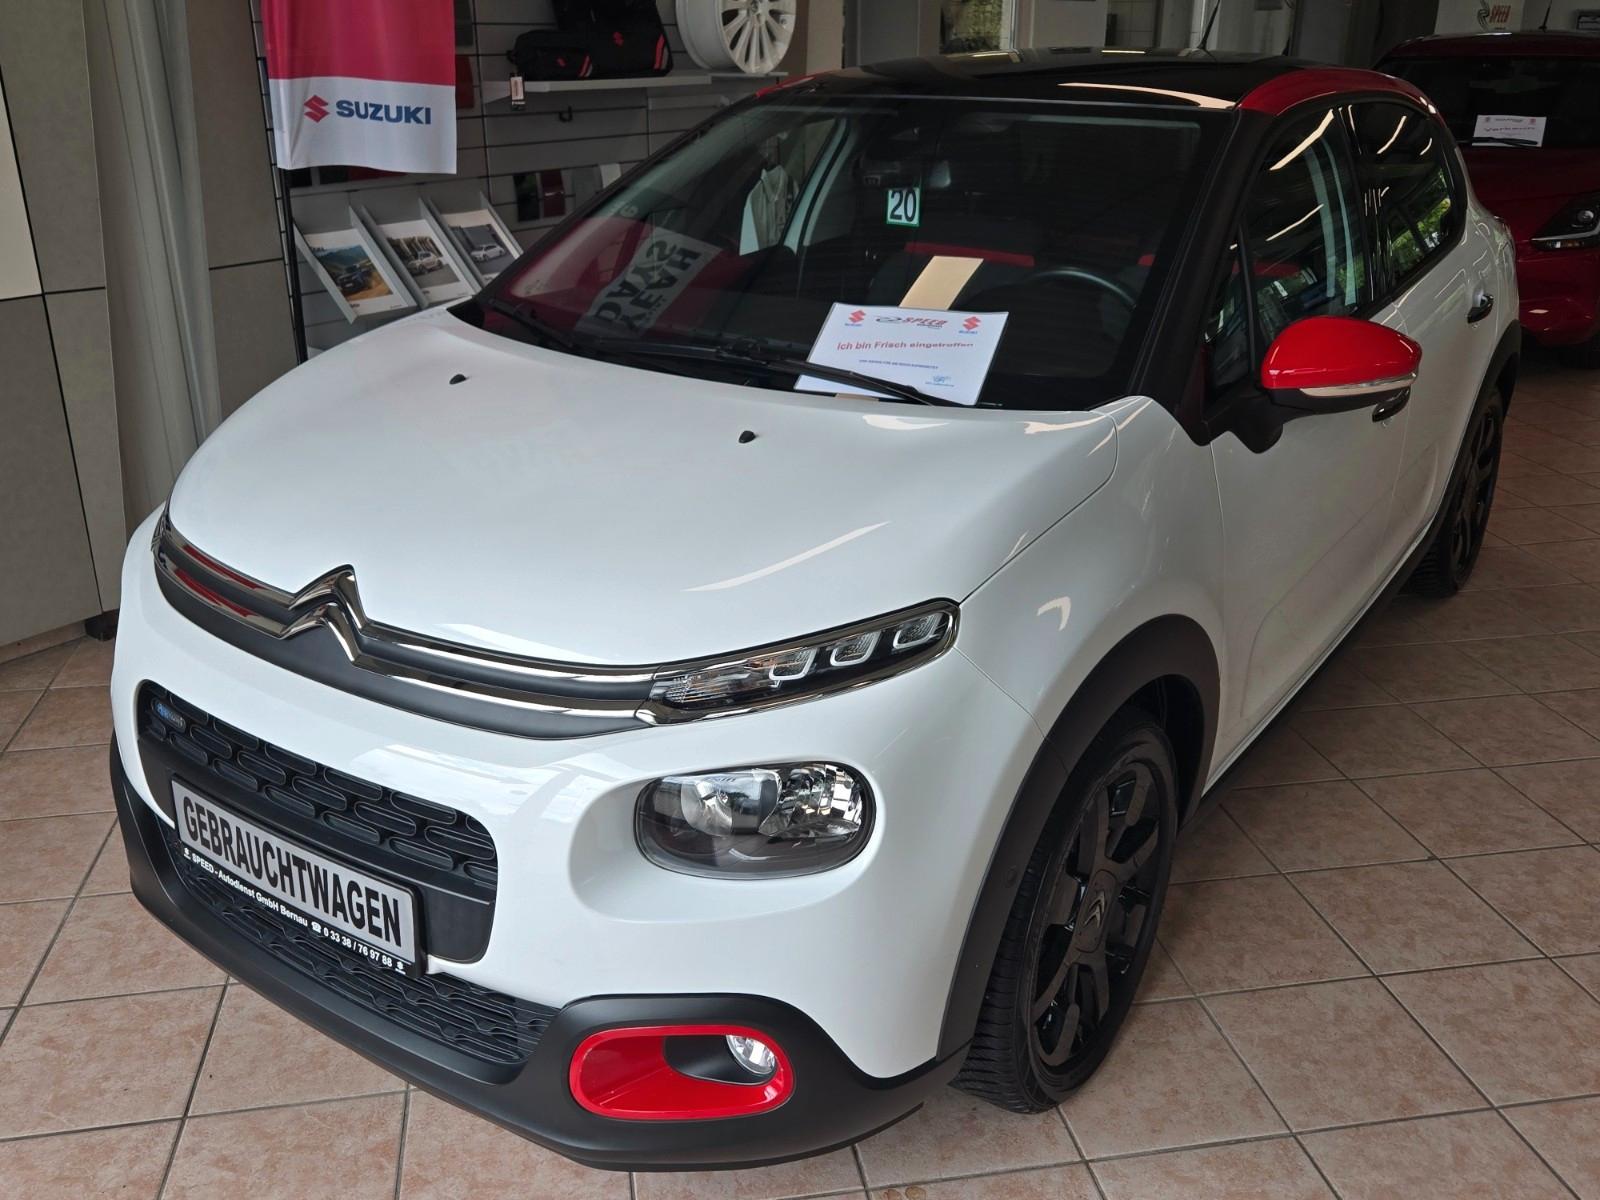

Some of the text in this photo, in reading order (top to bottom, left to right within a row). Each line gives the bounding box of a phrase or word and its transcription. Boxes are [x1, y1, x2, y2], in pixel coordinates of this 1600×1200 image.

[336, 100, 431, 125] SUZUKI
[889, 190, 917, 222] 20
[837, 342, 853, 350] Ich
[855, 342, 872, 350] bin
[874, 341, 907, 349] Frisch
[183, 796, 401, 948] GEBRAUCHTWAGEN
[192, 853, 215, 875] SPEED
[218, 867, 256, 898] Autodienst
[256, 892, 279, 912] GmbH
[280, 905, 308, 927] Bernau
[323, 927, 329, 937] 0
[330, 930, 340, 942] 33
[342, 936, 351, 948] 38
[358, 943, 368, 956] 76
[370, 949, 380, 961] 97
